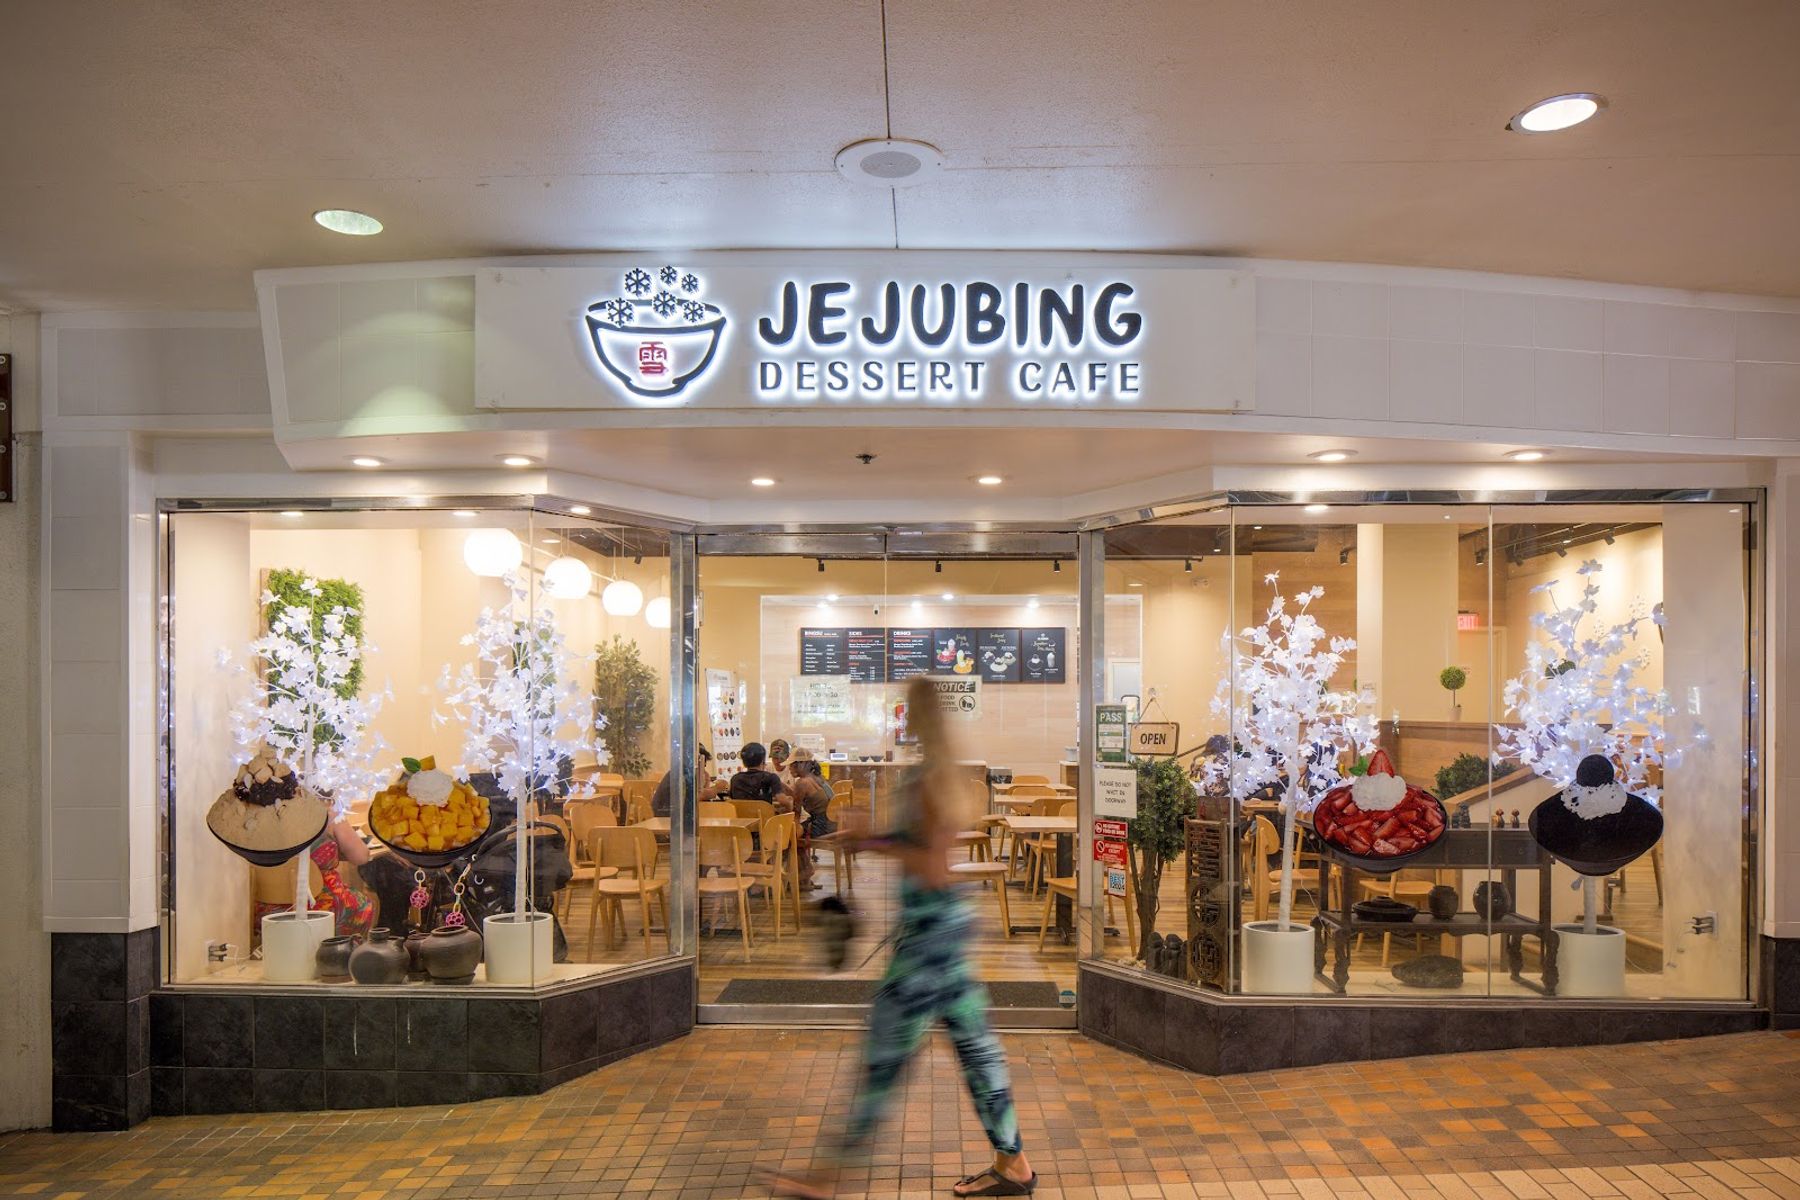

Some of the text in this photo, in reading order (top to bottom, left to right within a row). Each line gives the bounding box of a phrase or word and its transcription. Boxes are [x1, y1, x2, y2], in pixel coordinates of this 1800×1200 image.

[759, 281, 1142, 346] JEJUBING
[639, 341, 668, 374] 雪
[760, 361, 1139, 393] DESSERT CAFE
[933, 682, 971, 692] NOTICE
[1100, 712, 1122, 722] PASS
[1140, 733, 1167, 745] OPEN
